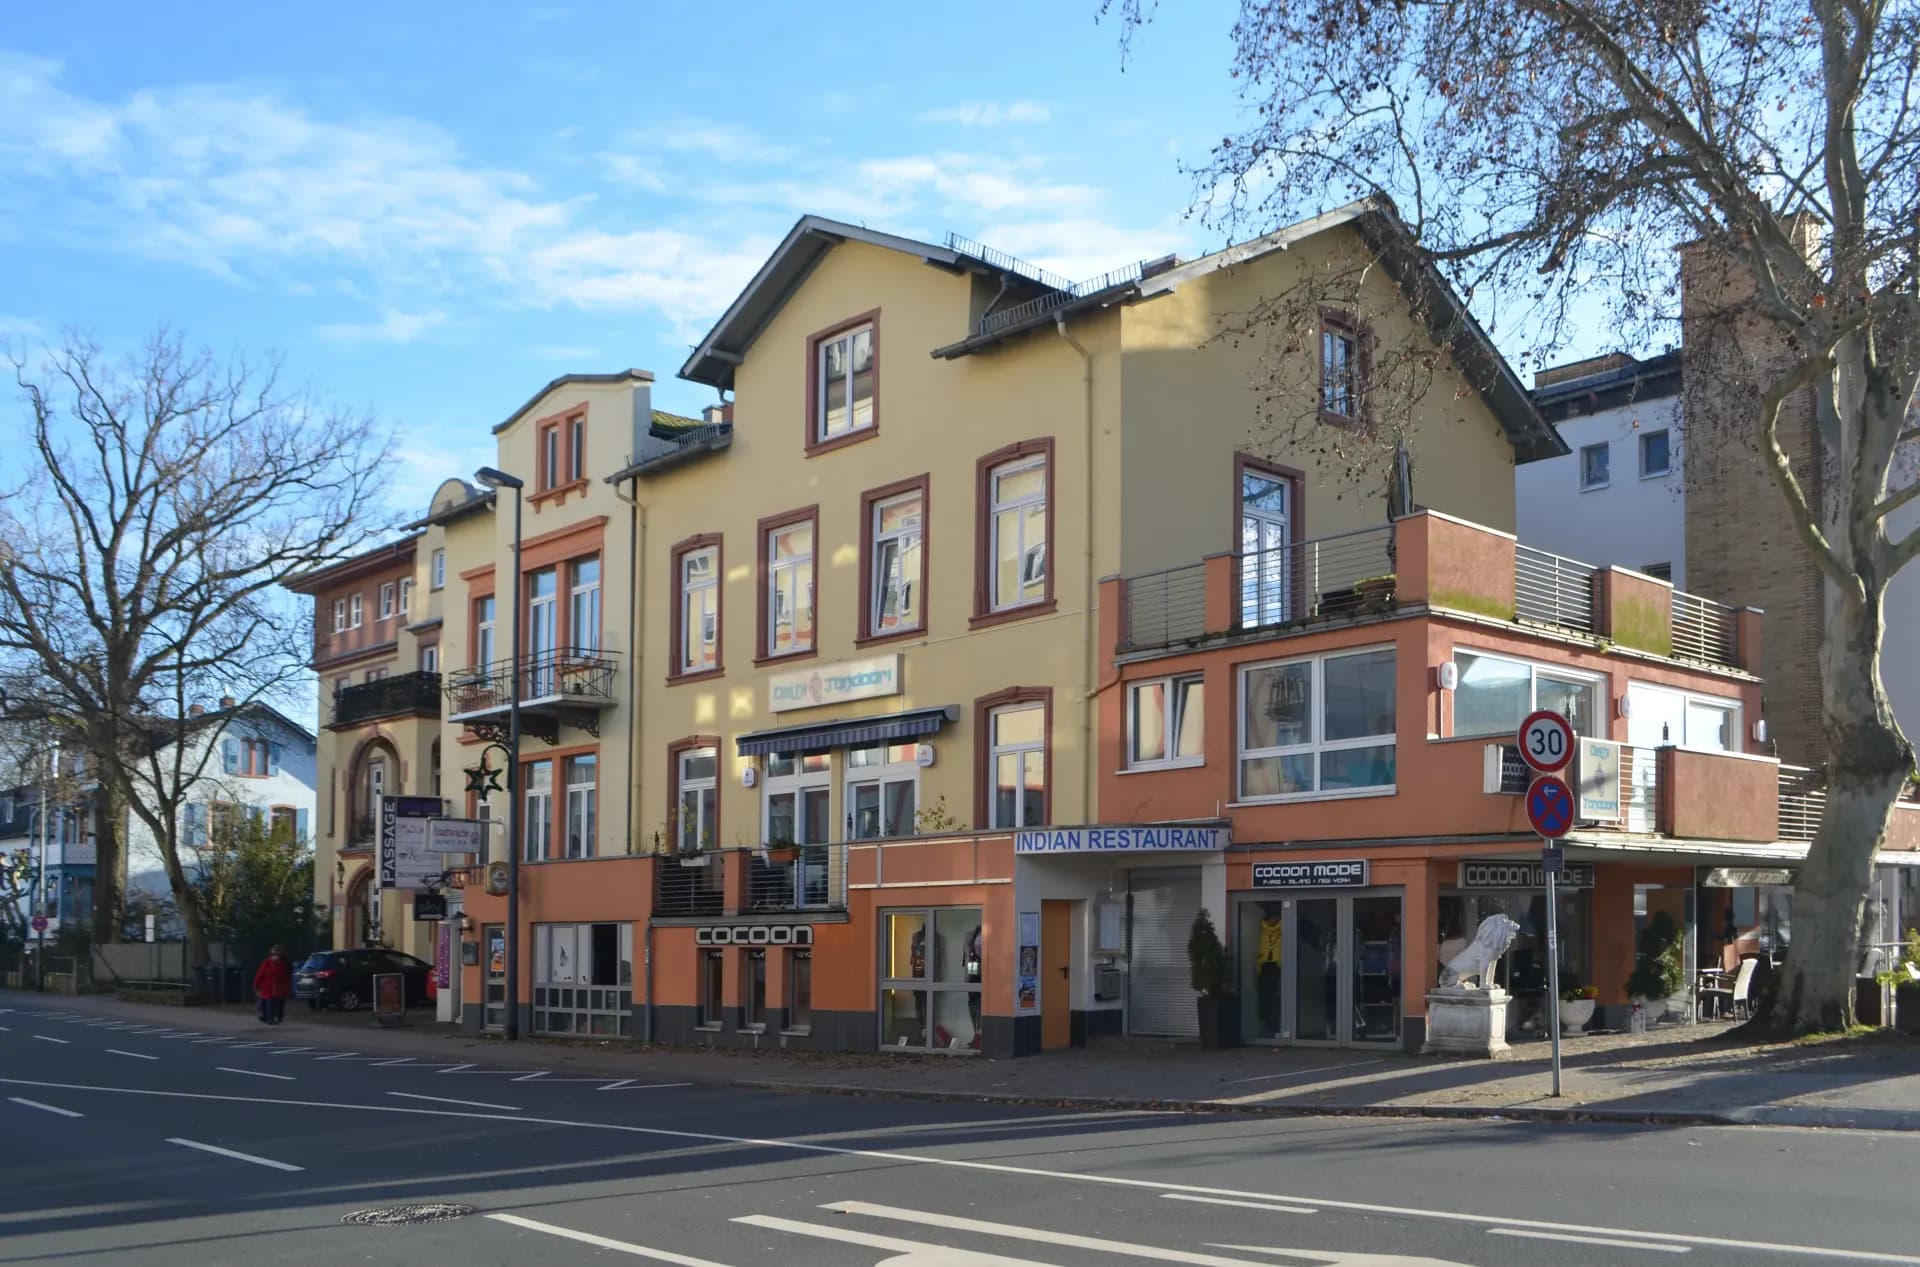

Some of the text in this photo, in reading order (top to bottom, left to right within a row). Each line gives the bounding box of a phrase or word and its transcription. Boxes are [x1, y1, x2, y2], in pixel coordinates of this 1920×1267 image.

[1531, 728, 1563, 756] 30
[383, 801, 396, 882] PASSAGE
[1016, 829, 1219, 851] INDIAN RESTAURANT
[1255, 865, 1361, 877] COCOON MODE
[1467, 866, 1531, 885] COCOON
[696, 925, 813, 944] COCOON
